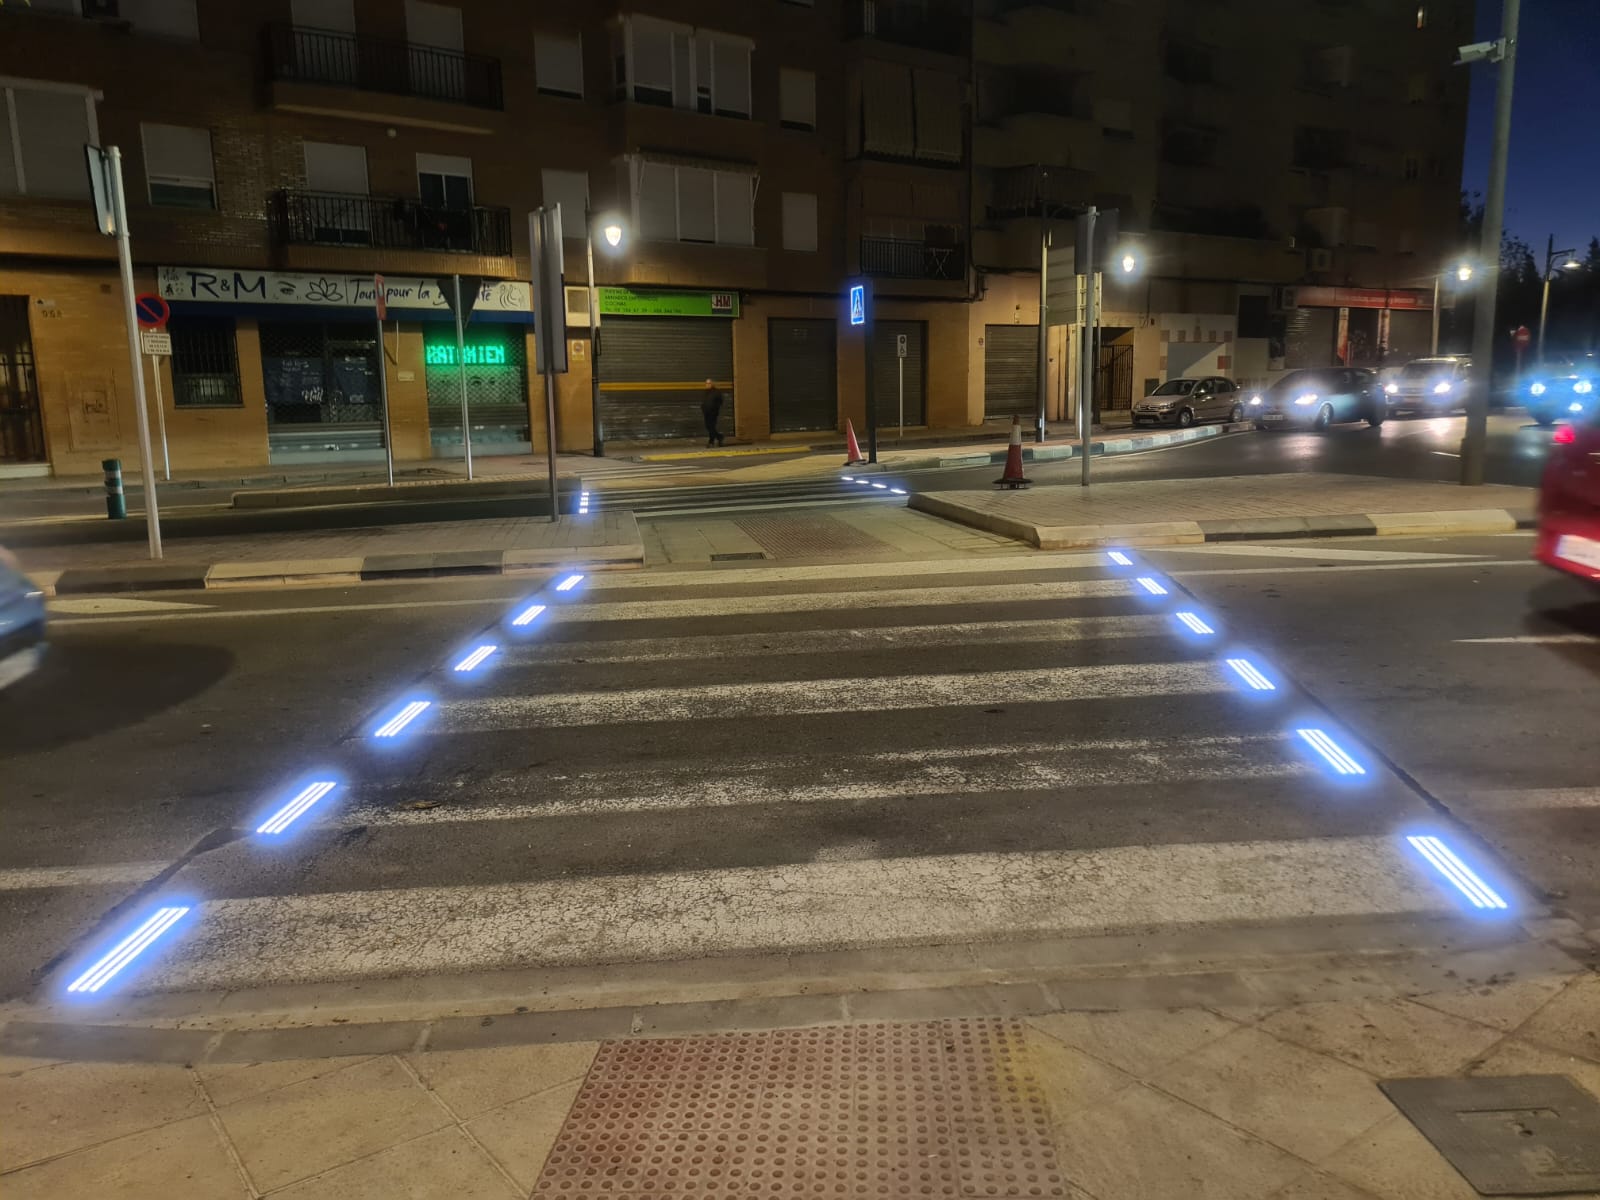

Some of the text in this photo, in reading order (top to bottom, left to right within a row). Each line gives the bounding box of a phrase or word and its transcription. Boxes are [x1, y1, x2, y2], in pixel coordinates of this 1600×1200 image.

[187, 271, 266, 299] R&M
[386, 287, 414, 304] pour
[418, 280, 430, 300] la
[426, 345, 505, 364] RATMIEN
